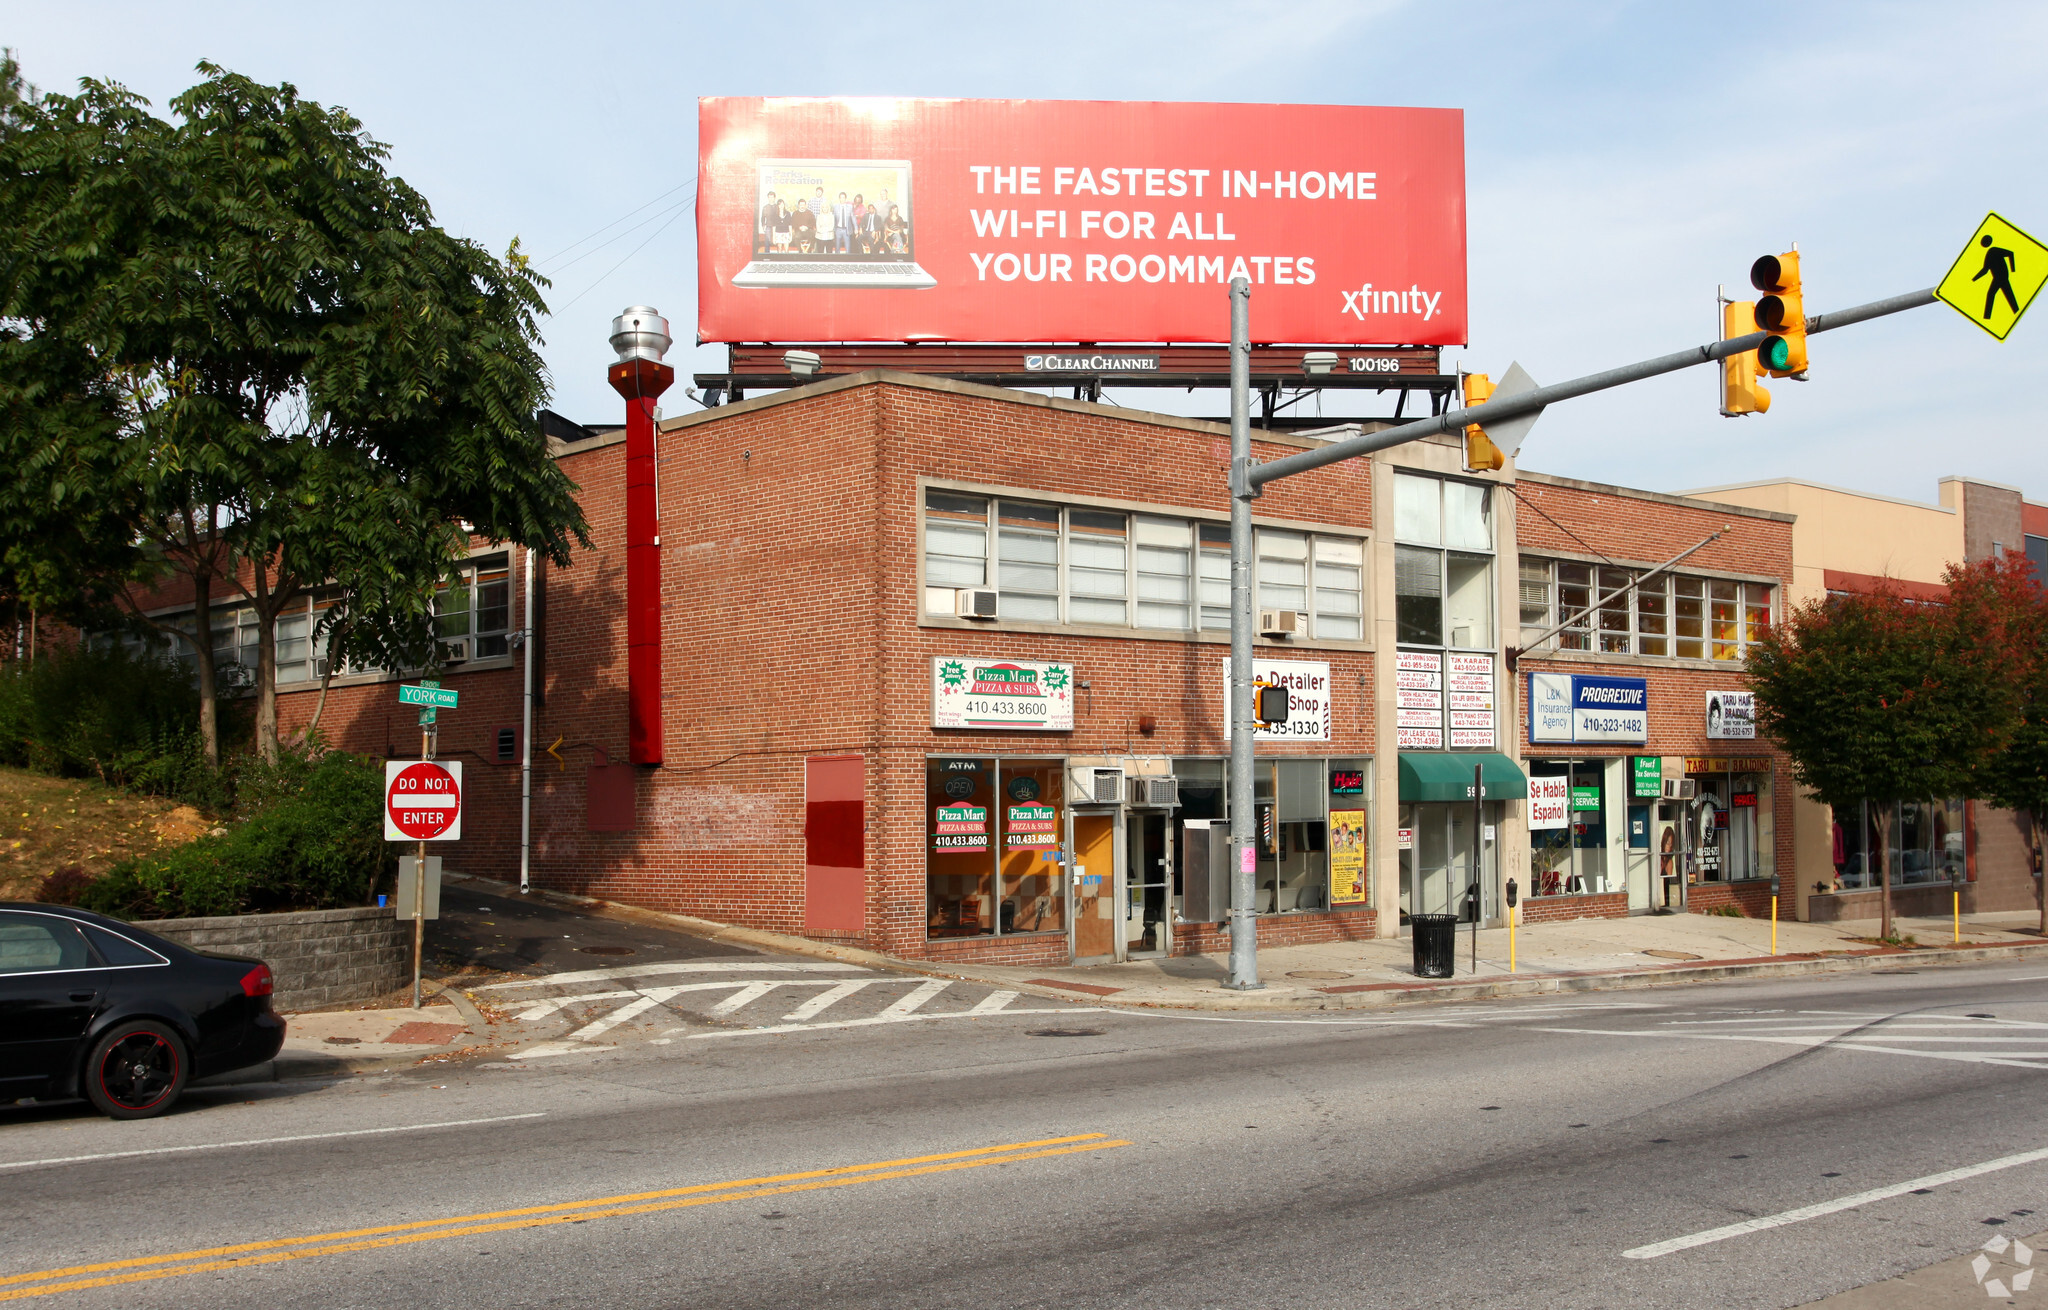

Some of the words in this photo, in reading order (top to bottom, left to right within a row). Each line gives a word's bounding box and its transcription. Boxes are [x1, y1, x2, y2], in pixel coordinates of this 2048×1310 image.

[765, 176, 823, 185] Recreation
[970, 166, 1041, 195] THE
[1055, 167, 1210, 197] FASTEST
[1222, 170, 1377, 200] IN-HOME
[970, 209, 1066, 238] WI-FI
[1081, 210, 1155, 240] FOR
[1167, 212, 1236, 241] ALL
[969, 253, 1073, 282] YOUR
[1086, 254, 1316, 285] ROOMMATES
[1341, 283, 1442, 321] xfinity
[1350, 358, 1400, 372] 100196
[946, 666, 960, 674] free
[976, 668, 1006, 682] Pizza
[1009, 670, 1036, 683] Mart
[1048, 671, 1064, 680] carry
[1270, 671, 1325, 690] Detailer
[975, 683, 1003, 693] PIZZA
[1004, 684, 1012, 694] &
[1014, 684, 1037, 694] SUBS
[1546, 689, 1561, 700] L&K
[405, 688, 437, 703] YORK
[437, 694, 455, 703] ROAD
[1580, 686, 1643, 704] PROGRESSIVE
[1723, 695, 1737, 706] TARU
[966, 701, 1047, 715] 410.433.8600
[1289, 695, 1319, 715] Shop
[1538, 702, 1571, 714] Insurance
[1543, 715, 1567, 729] Agency
[1583, 718, 1642, 732] 410-323-1482
[948, 762, 976, 770] ATM
[1687, 760, 1709, 772] TARU
[1733, 759, 1769, 771] BRAIDING
[399, 778, 417, 790] DO
[425, 778, 450, 790] NOT
[1334, 772, 1362, 787] Hair
[945, 781, 974, 793] OPEN
[1530, 781, 1540, 798] Se
[1543, 780, 1566, 798] Habla
[1575, 797, 1599, 806] SERVICE
[403, 812, 444, 824] ENTER
[939, 808, 962, 820] Pizza
[963, 808, 984, 820] Mart
[1010, 808, 1032, 819] Pizza
[1033, 808, 1053, 819] Mart
[1533, 802, 1564, 824] Español
[967, 823, 983, 831] SUBS
[1037, 822, 1052, 830] SUBS
[936, 836, 987, 846] 410.433.8600
[1007, 834, 1056, 844] 410.433.8600
[1042, 851, 1062, 861] ATM
[1083, 874, 1102, 885] ATM
